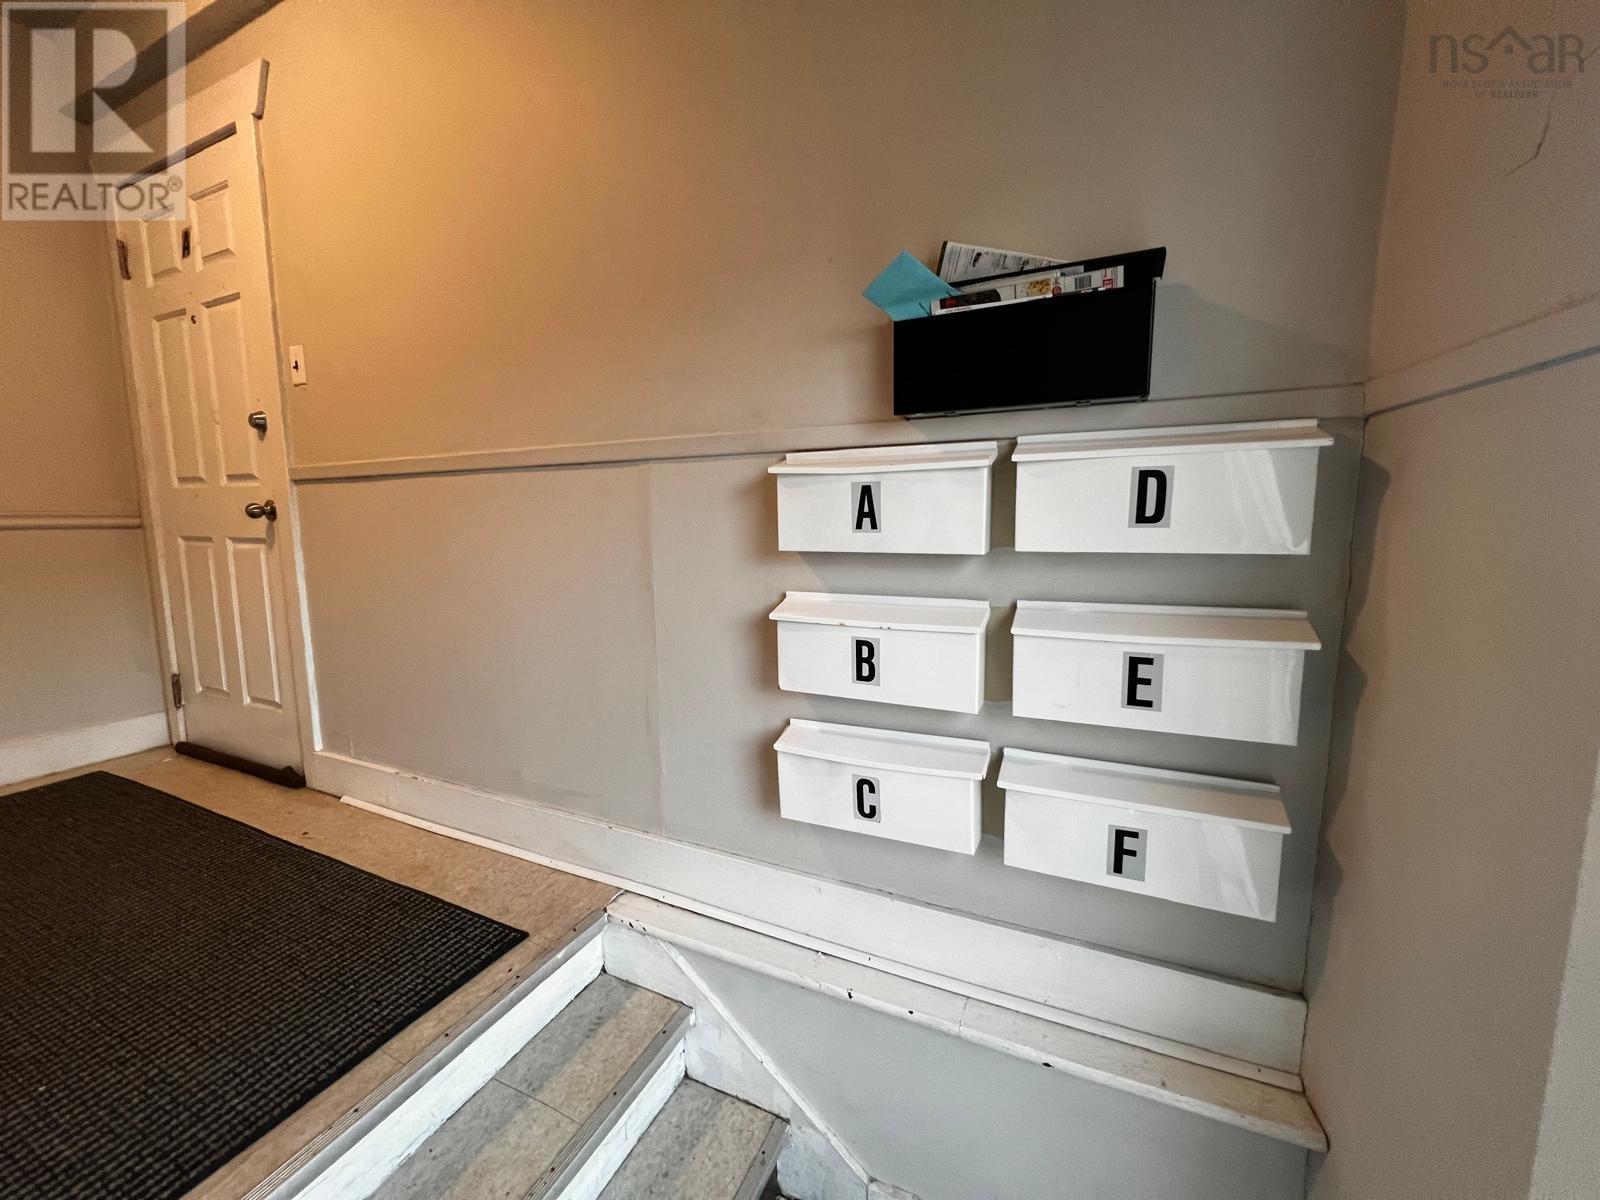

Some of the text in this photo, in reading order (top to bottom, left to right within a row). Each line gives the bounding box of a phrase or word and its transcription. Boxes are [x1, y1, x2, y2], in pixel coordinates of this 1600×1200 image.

[182, 230, 191, 257] A
[856, 485, 877, 529] A
[1135, 470, 1167, 523] D
[856, 640, 875, 682] B
[1127, 656, 1154, 708] E
[857, 779, 876, 818] C
[1113, 829, 1139, 874] F
